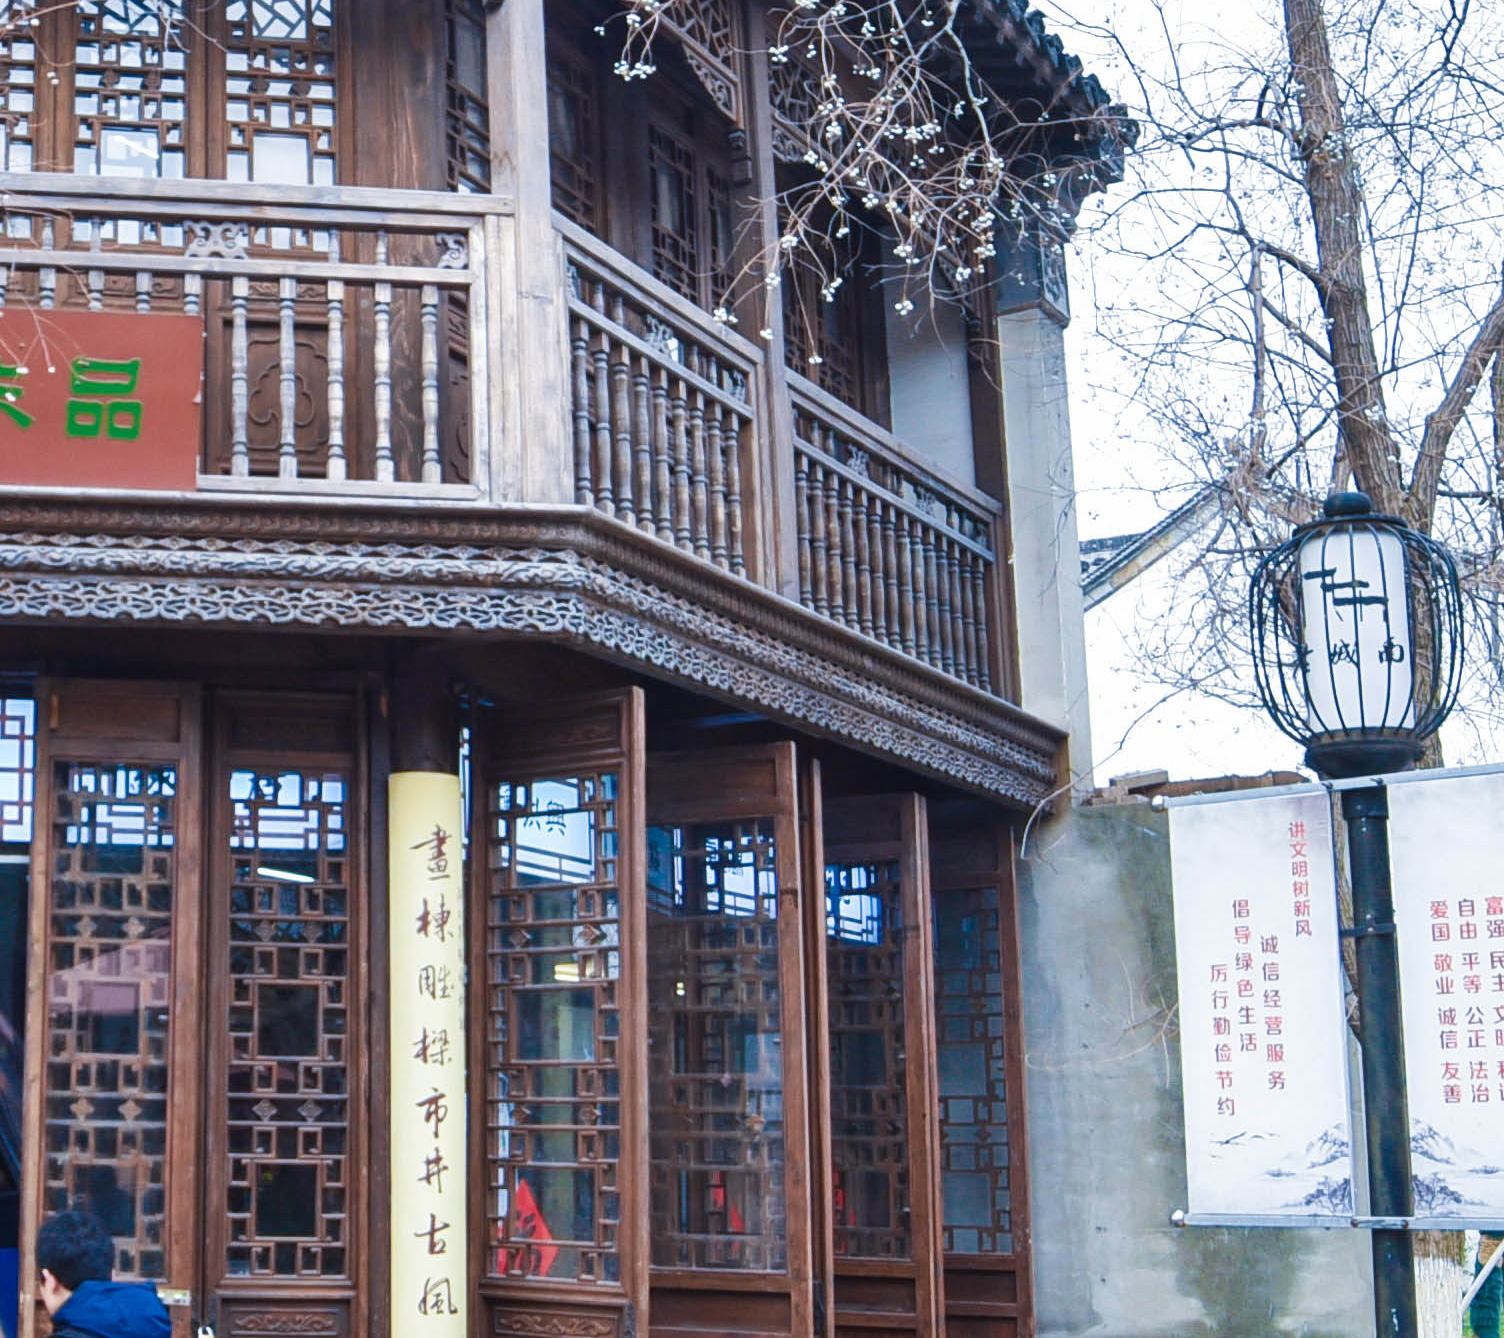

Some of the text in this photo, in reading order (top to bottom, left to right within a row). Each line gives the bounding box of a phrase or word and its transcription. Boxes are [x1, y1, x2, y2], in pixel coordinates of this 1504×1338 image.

[1288, 821, 1312, 937] 讲文明树新风
[1210, 963, 1236, 1117] 厉行勤俭节约
[1232, 899, 1258, 1053] 倡导绿色生活
[1260, 936, 1287, 1091] 诚信经营服务
[1429, 901, 1462, 1104] 爱国 敬业 诚信 友善
[1458, 899, 1490, 1103] 自由 平等 公正 法治
